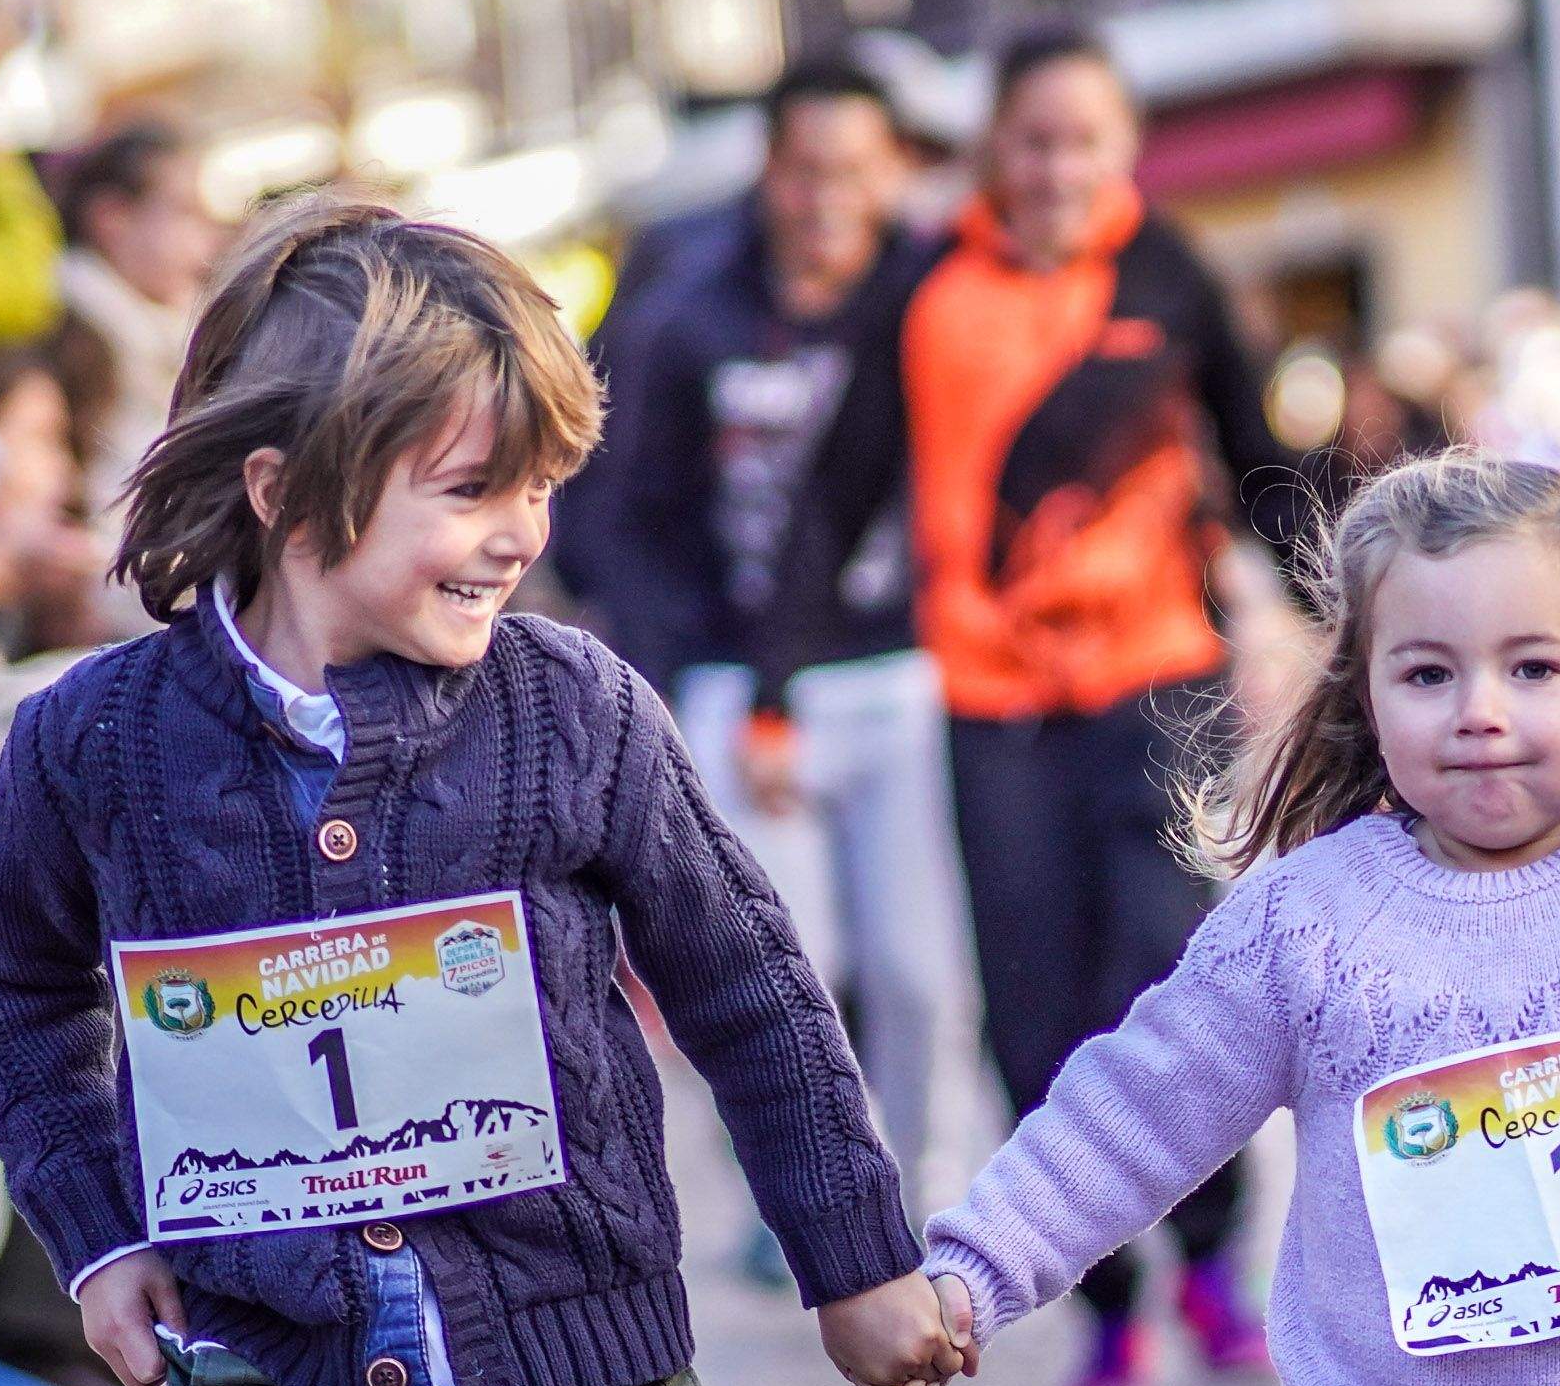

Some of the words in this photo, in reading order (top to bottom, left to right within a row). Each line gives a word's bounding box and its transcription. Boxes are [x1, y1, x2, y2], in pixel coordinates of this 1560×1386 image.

[258, 932, 369, 976] CARRERA
[371, 933, 388, 946] DE
[260, 947, 391, 1001] NAVIDAD
[447, 967, 458, 982] 7
[308, 1027, 359, 1131] 1
[301, 1170, 368, 1195] Trail
[367, 1163, 428, 1186] Run
